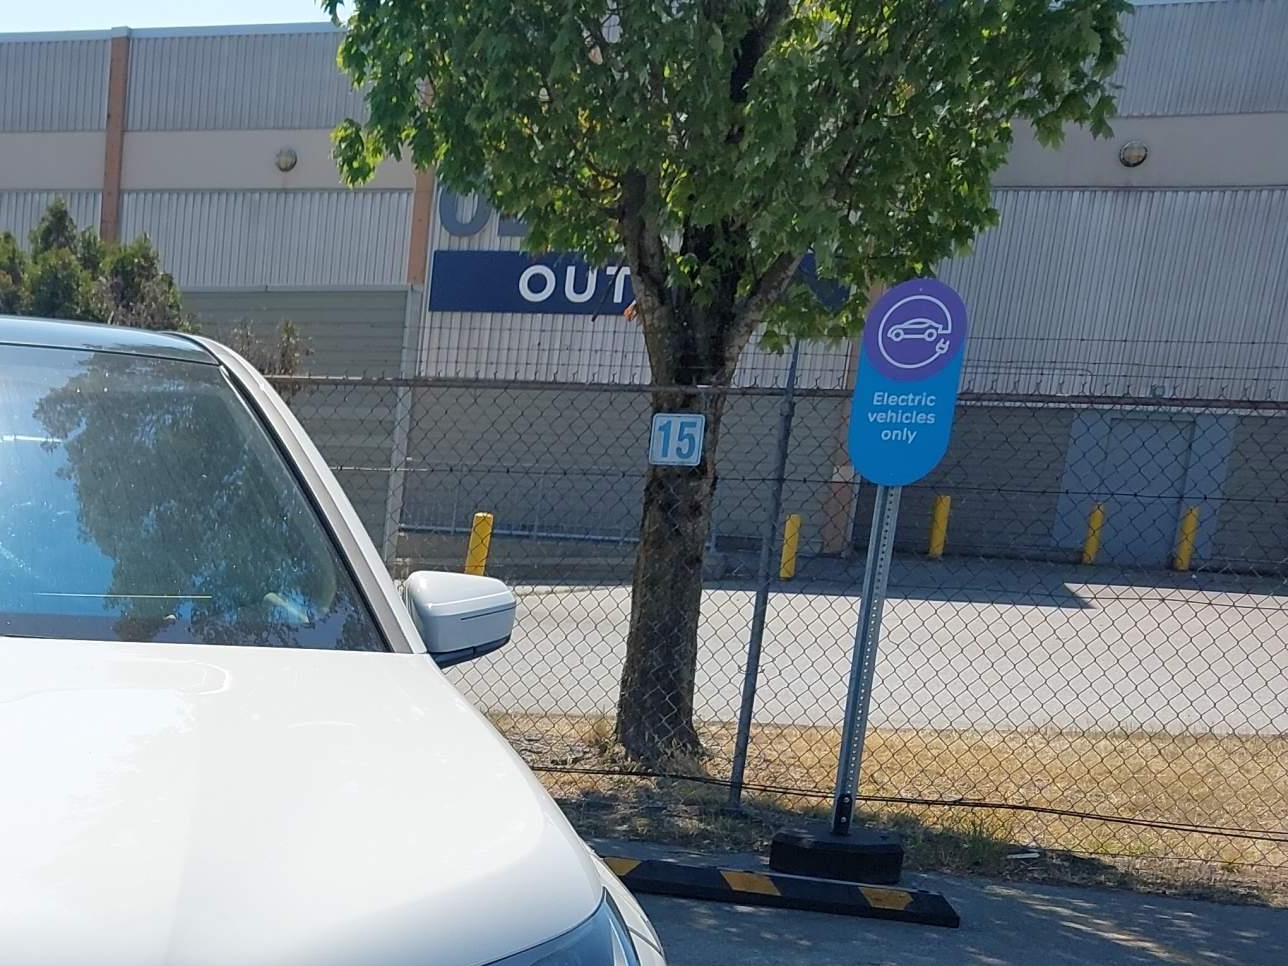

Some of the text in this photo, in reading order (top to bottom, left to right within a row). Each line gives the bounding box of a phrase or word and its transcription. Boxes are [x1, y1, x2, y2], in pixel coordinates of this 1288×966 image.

[518, 260, 631, 304] OUT
[872, 391, 937, 407] Electric
[867, 409, 937, 425] vehicles
[657, 419, 698, 460] 15
[880, 427, 918, 444] only
